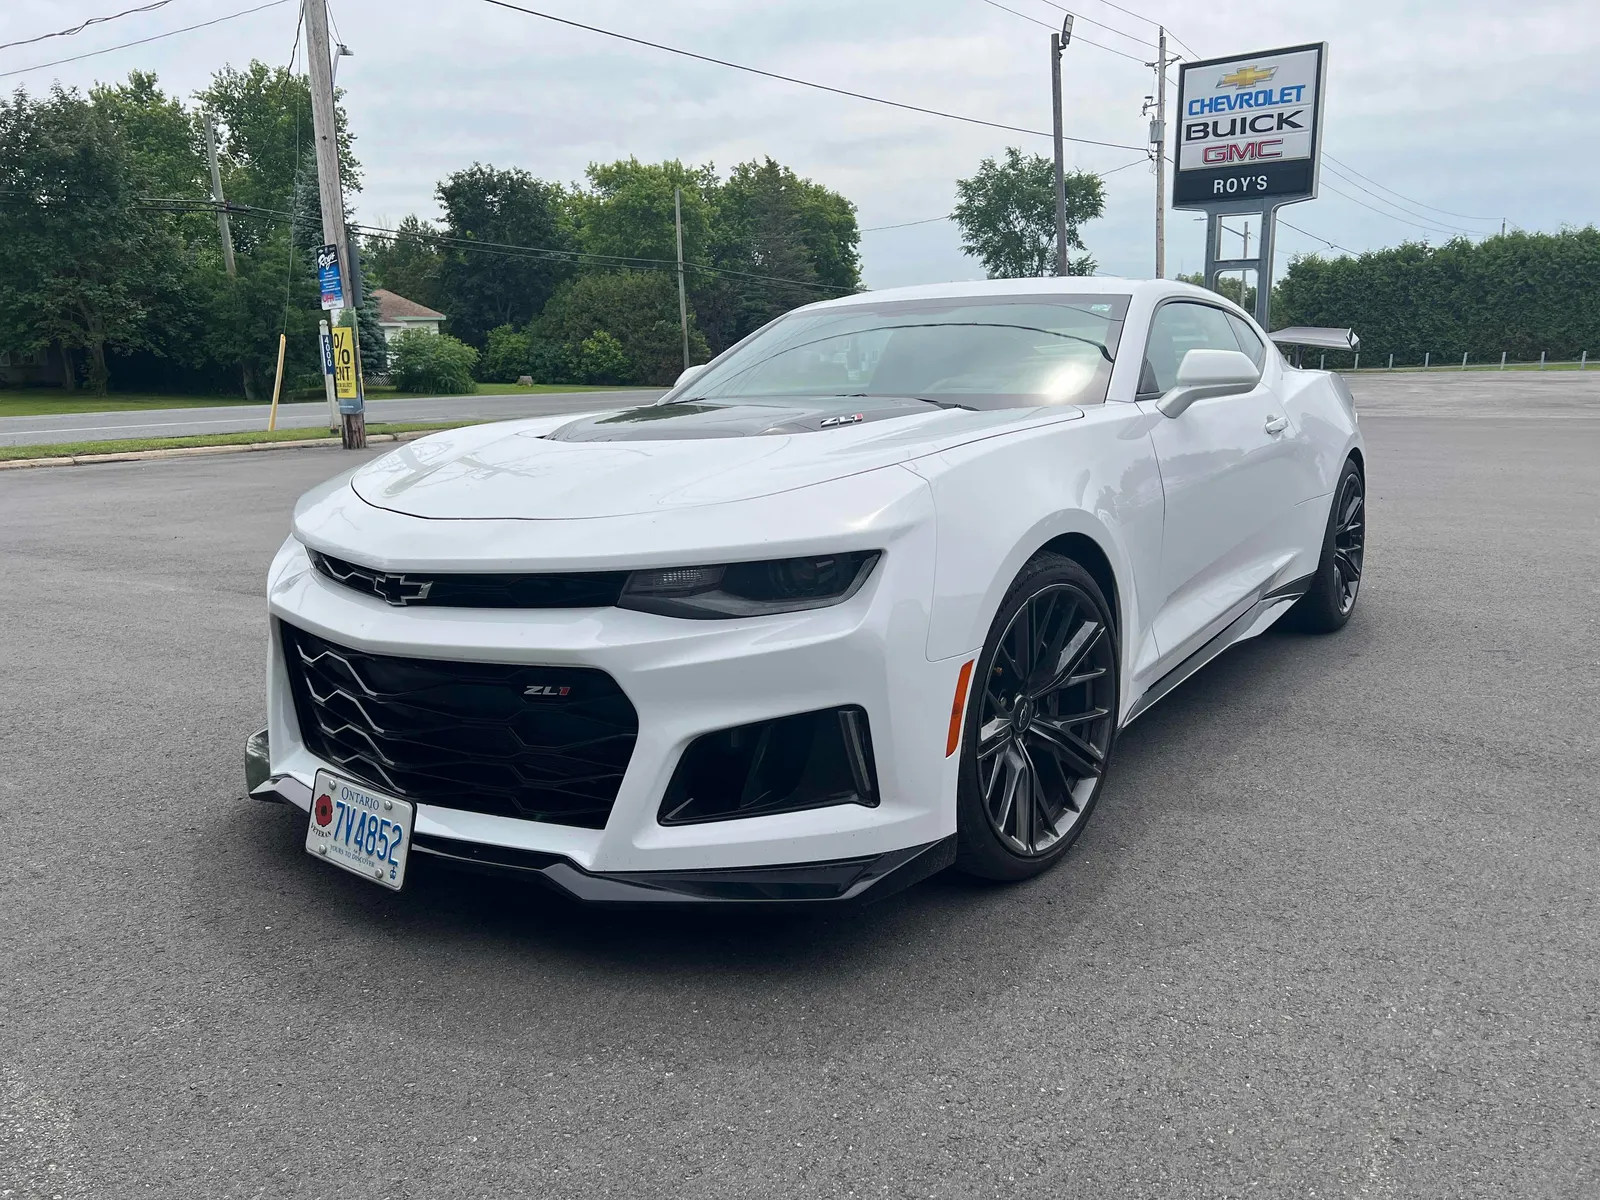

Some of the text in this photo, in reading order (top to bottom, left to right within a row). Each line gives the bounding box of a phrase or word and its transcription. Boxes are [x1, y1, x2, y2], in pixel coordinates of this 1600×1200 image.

[1189, 85, 1306, 115] CHEVROLET
[1186, 110, 1304, 141] BUICK
[1202, 139, 1283, 165] GMC
[1213, 176, 1268, 194] ROY'S
[524, 685, 571, 696] ZL1
[342, 787, 379, 810] ONTARIO
[311, 823, 331, 837] VETERAN
[334, 800, 402, 866] 7V4852
